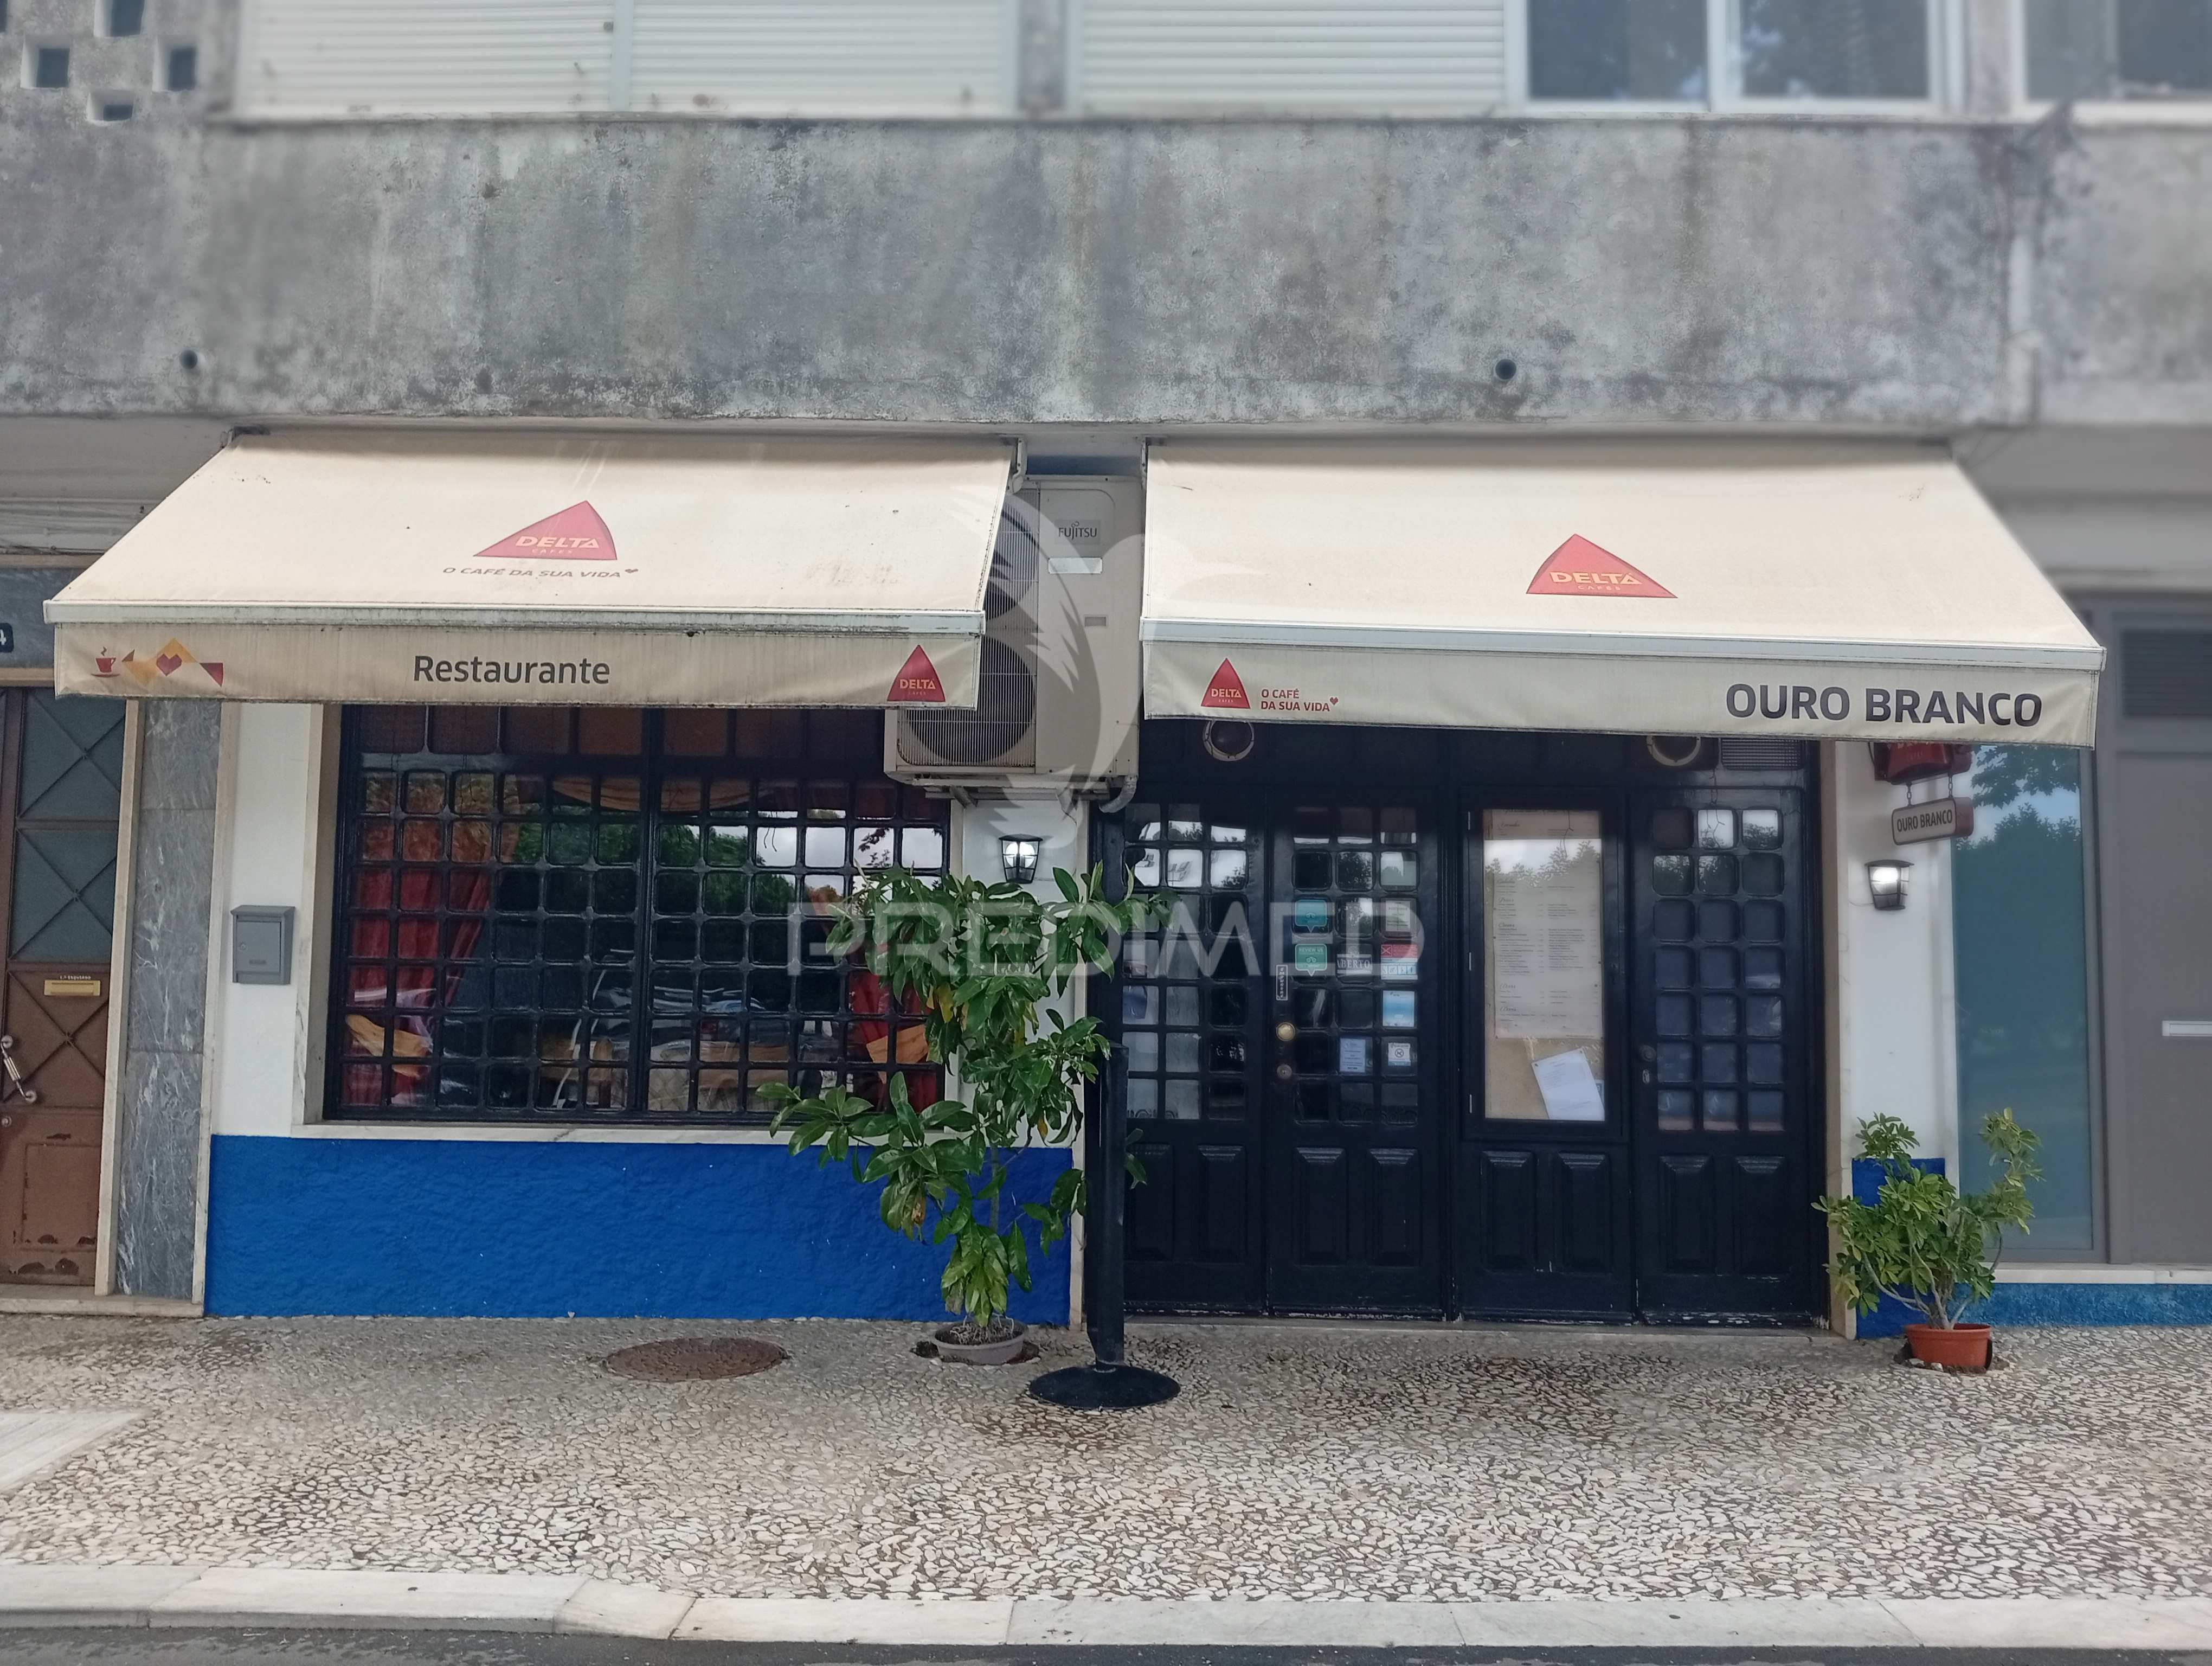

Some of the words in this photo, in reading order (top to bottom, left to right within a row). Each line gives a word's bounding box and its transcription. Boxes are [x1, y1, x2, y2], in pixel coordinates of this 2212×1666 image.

[1058, 521, 1097, 540] FUJITSU
[516, 536, 599, 548] DELTA
[1549, 572, 1643, 585] DELTA
[414, 656, 610, 684] Restaurante
[900, 680, 936, 689] DELTA
[1211, 689, 1242, 698] DELTA
[1261, 689, 1269, 698] O
[1272, 688, 1300, 699] CAFÉ
[1261, 701, 1276, 710] DA
[1279, 701, 1300, 711] SUA
[1304, 702, 1330, 711] VIDA
[1726, 684, 1850, 720] OURO
[1866, 688, 2042, 727] BRANCO
[1897, 815, 1918, 832] OURO
[1920, 809, 1952, 828] BRANCO
